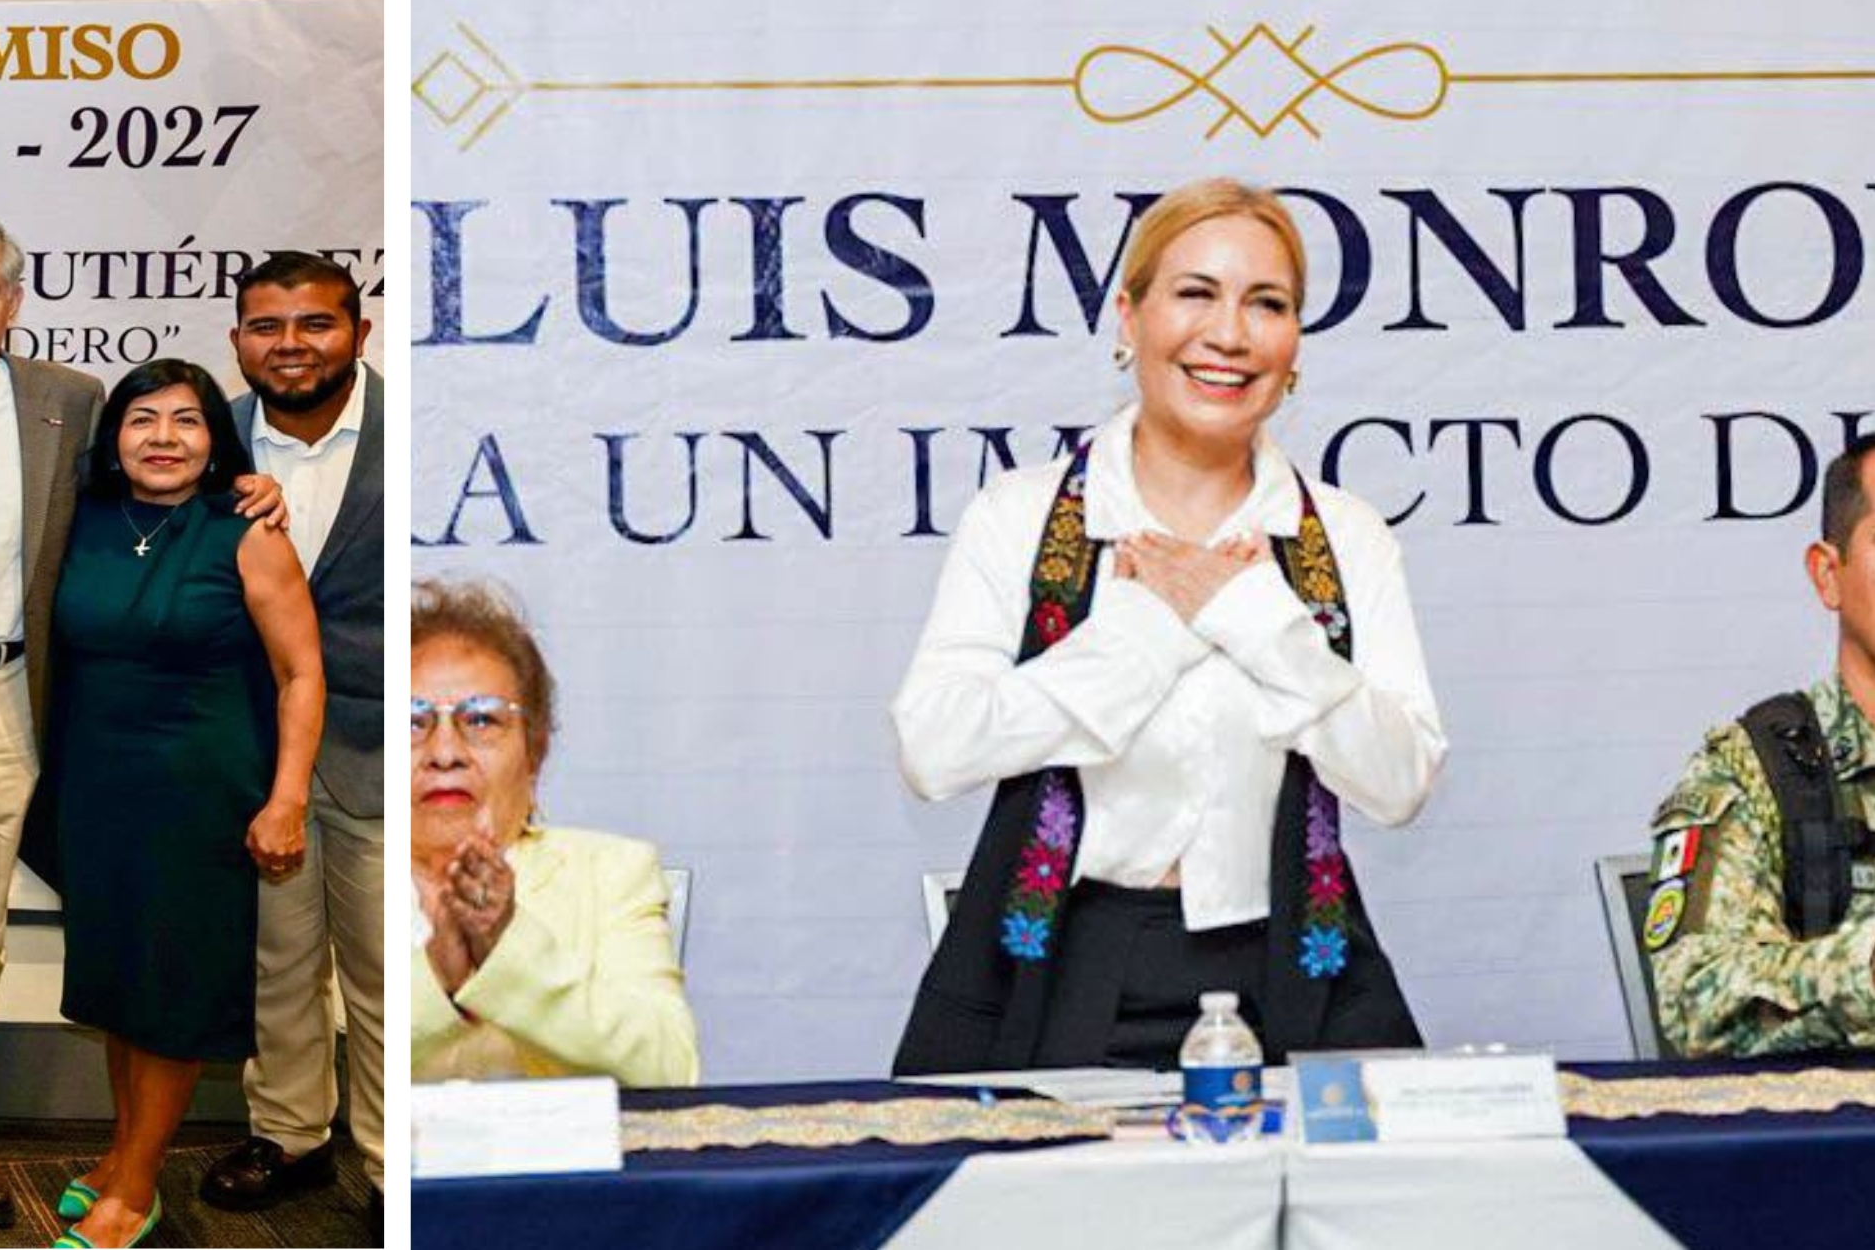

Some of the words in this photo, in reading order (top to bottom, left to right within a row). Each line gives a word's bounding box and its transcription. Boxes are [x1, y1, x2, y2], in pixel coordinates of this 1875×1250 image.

[67, 104, 261, 169] 2027
[411, 192, 936, 346] LUIS
[592, 431, 847, 546] UN
